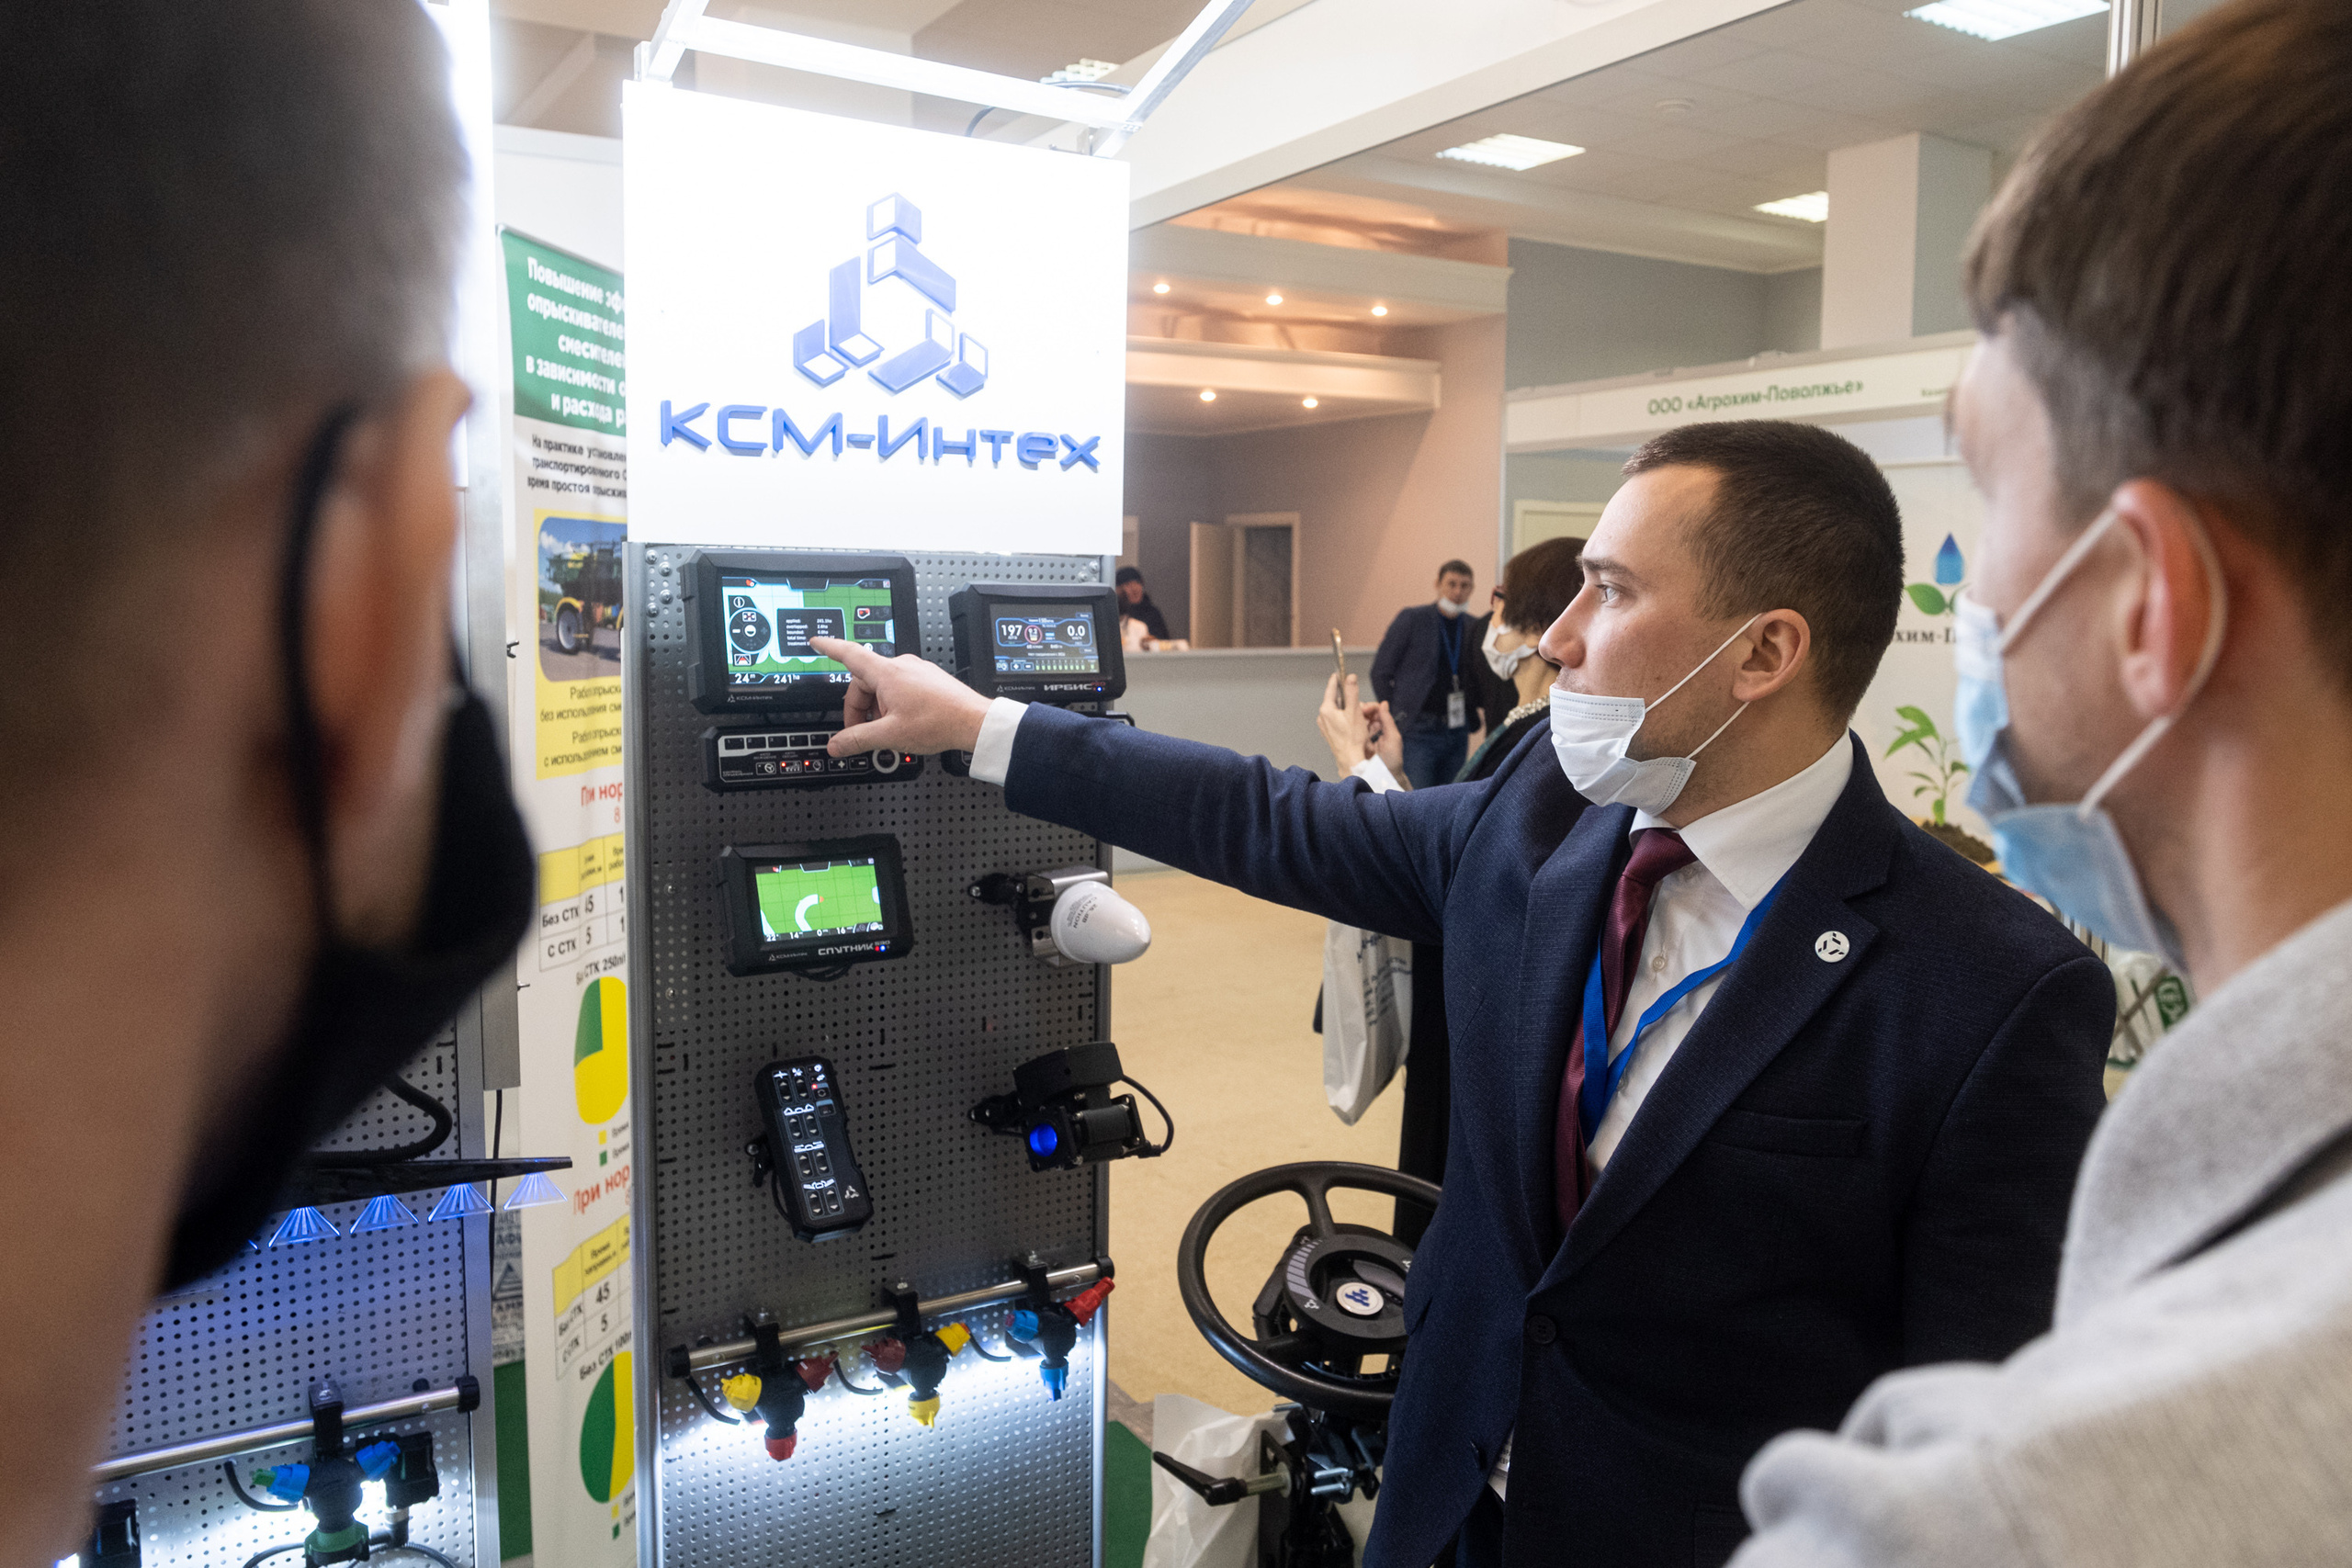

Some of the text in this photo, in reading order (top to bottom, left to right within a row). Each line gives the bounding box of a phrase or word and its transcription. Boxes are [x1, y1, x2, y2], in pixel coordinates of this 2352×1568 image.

[605, 289, 625, 315] эф
[526, 292, 625, 341] опрыскивателе
[1647, 396, 1682, 415] ООО
[661, 400, 1101, 472] КСМ-Интех
[1067, 625, 1086, 637] 0.0
[818, 942, 874, 956] СПУТНИК
[596, 1281, 611, 1304] 45
[600, 1313, 608, 1333] 5
